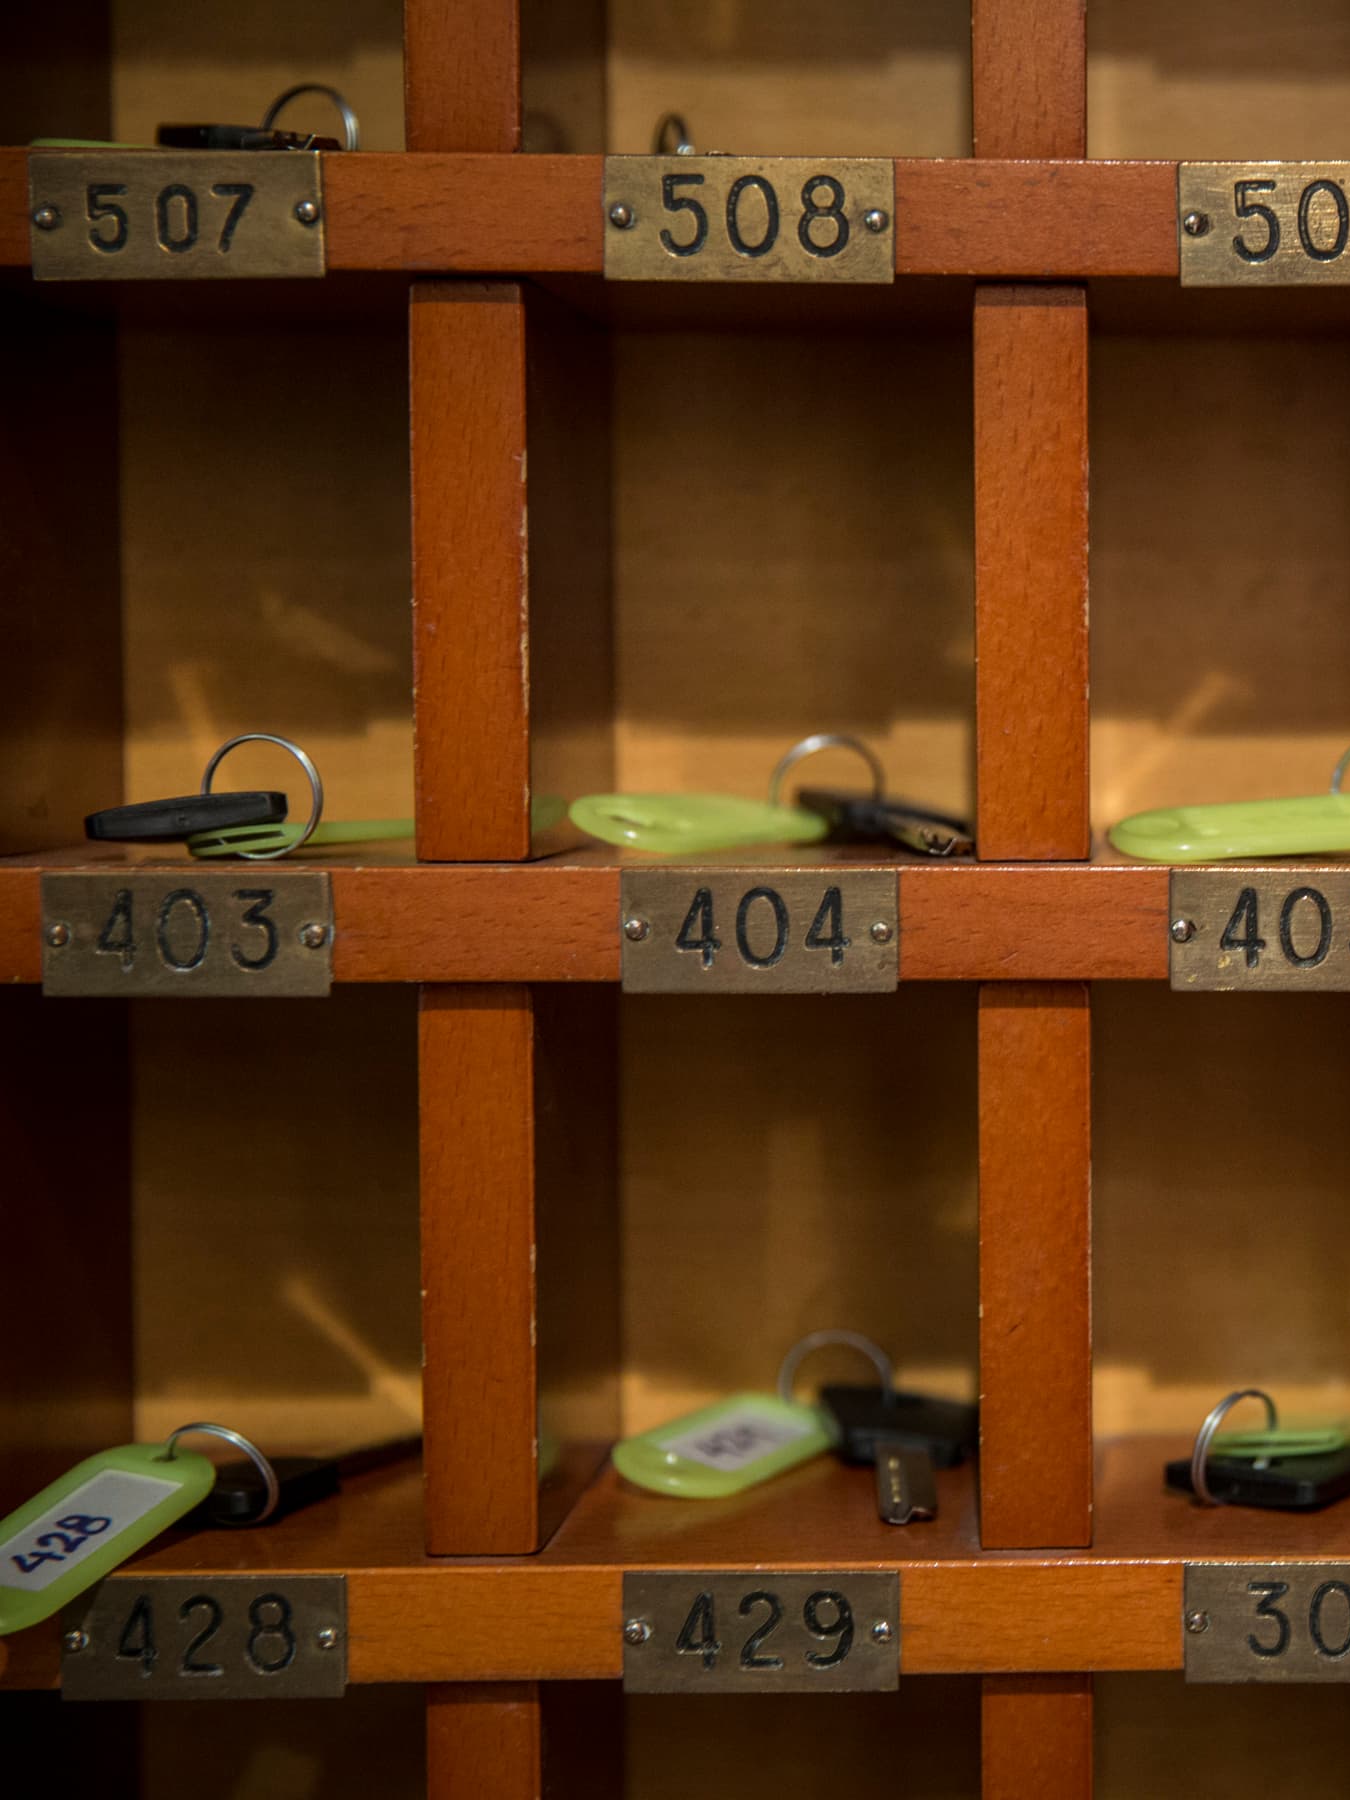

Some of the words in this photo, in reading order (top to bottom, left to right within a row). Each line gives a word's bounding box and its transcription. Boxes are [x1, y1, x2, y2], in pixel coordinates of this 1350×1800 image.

[86, 183, 255, 254] 507
[660, 173, 850, 257] 508
[96, 889, 278, 971] 403
[675, 887, 850, 969] 404
[10, 1514, 113, 1574] 428
[116, 1594, 296, 1678] 428
[675, 1590, 854, 1671] 429
